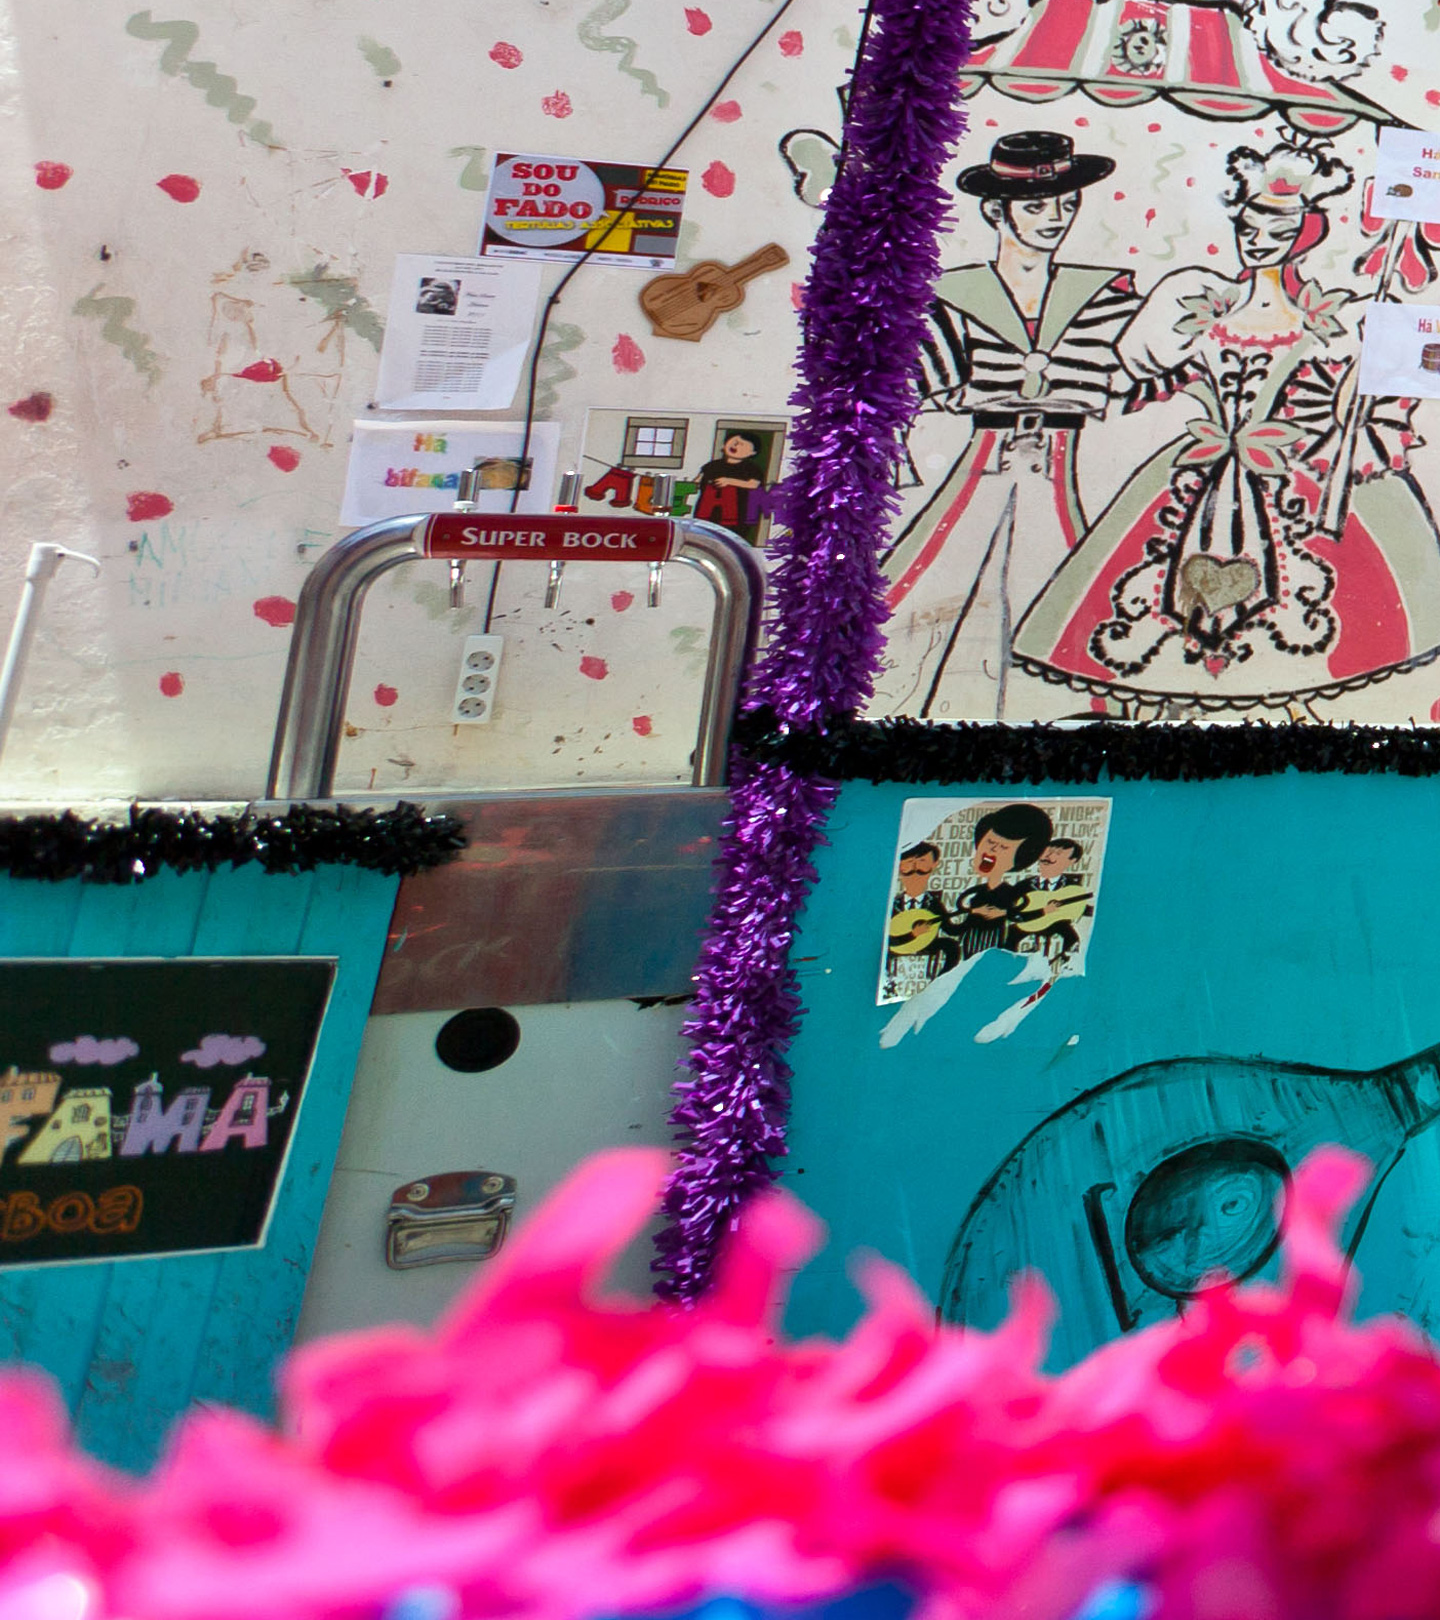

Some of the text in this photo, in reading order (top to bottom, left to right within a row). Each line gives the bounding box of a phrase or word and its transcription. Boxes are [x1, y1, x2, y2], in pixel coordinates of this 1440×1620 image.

[511, 162, 580, 181] SOU
[522, 182, 562, 197] DO
[493, 198, 593, 220] FADO
[1417, 318, 1433, 334] Há
[413, 433, 447, 454] Há
[461, 527, 638, 549] SUPER BOCK
[1071, 822, 1100, 838] LOVE
